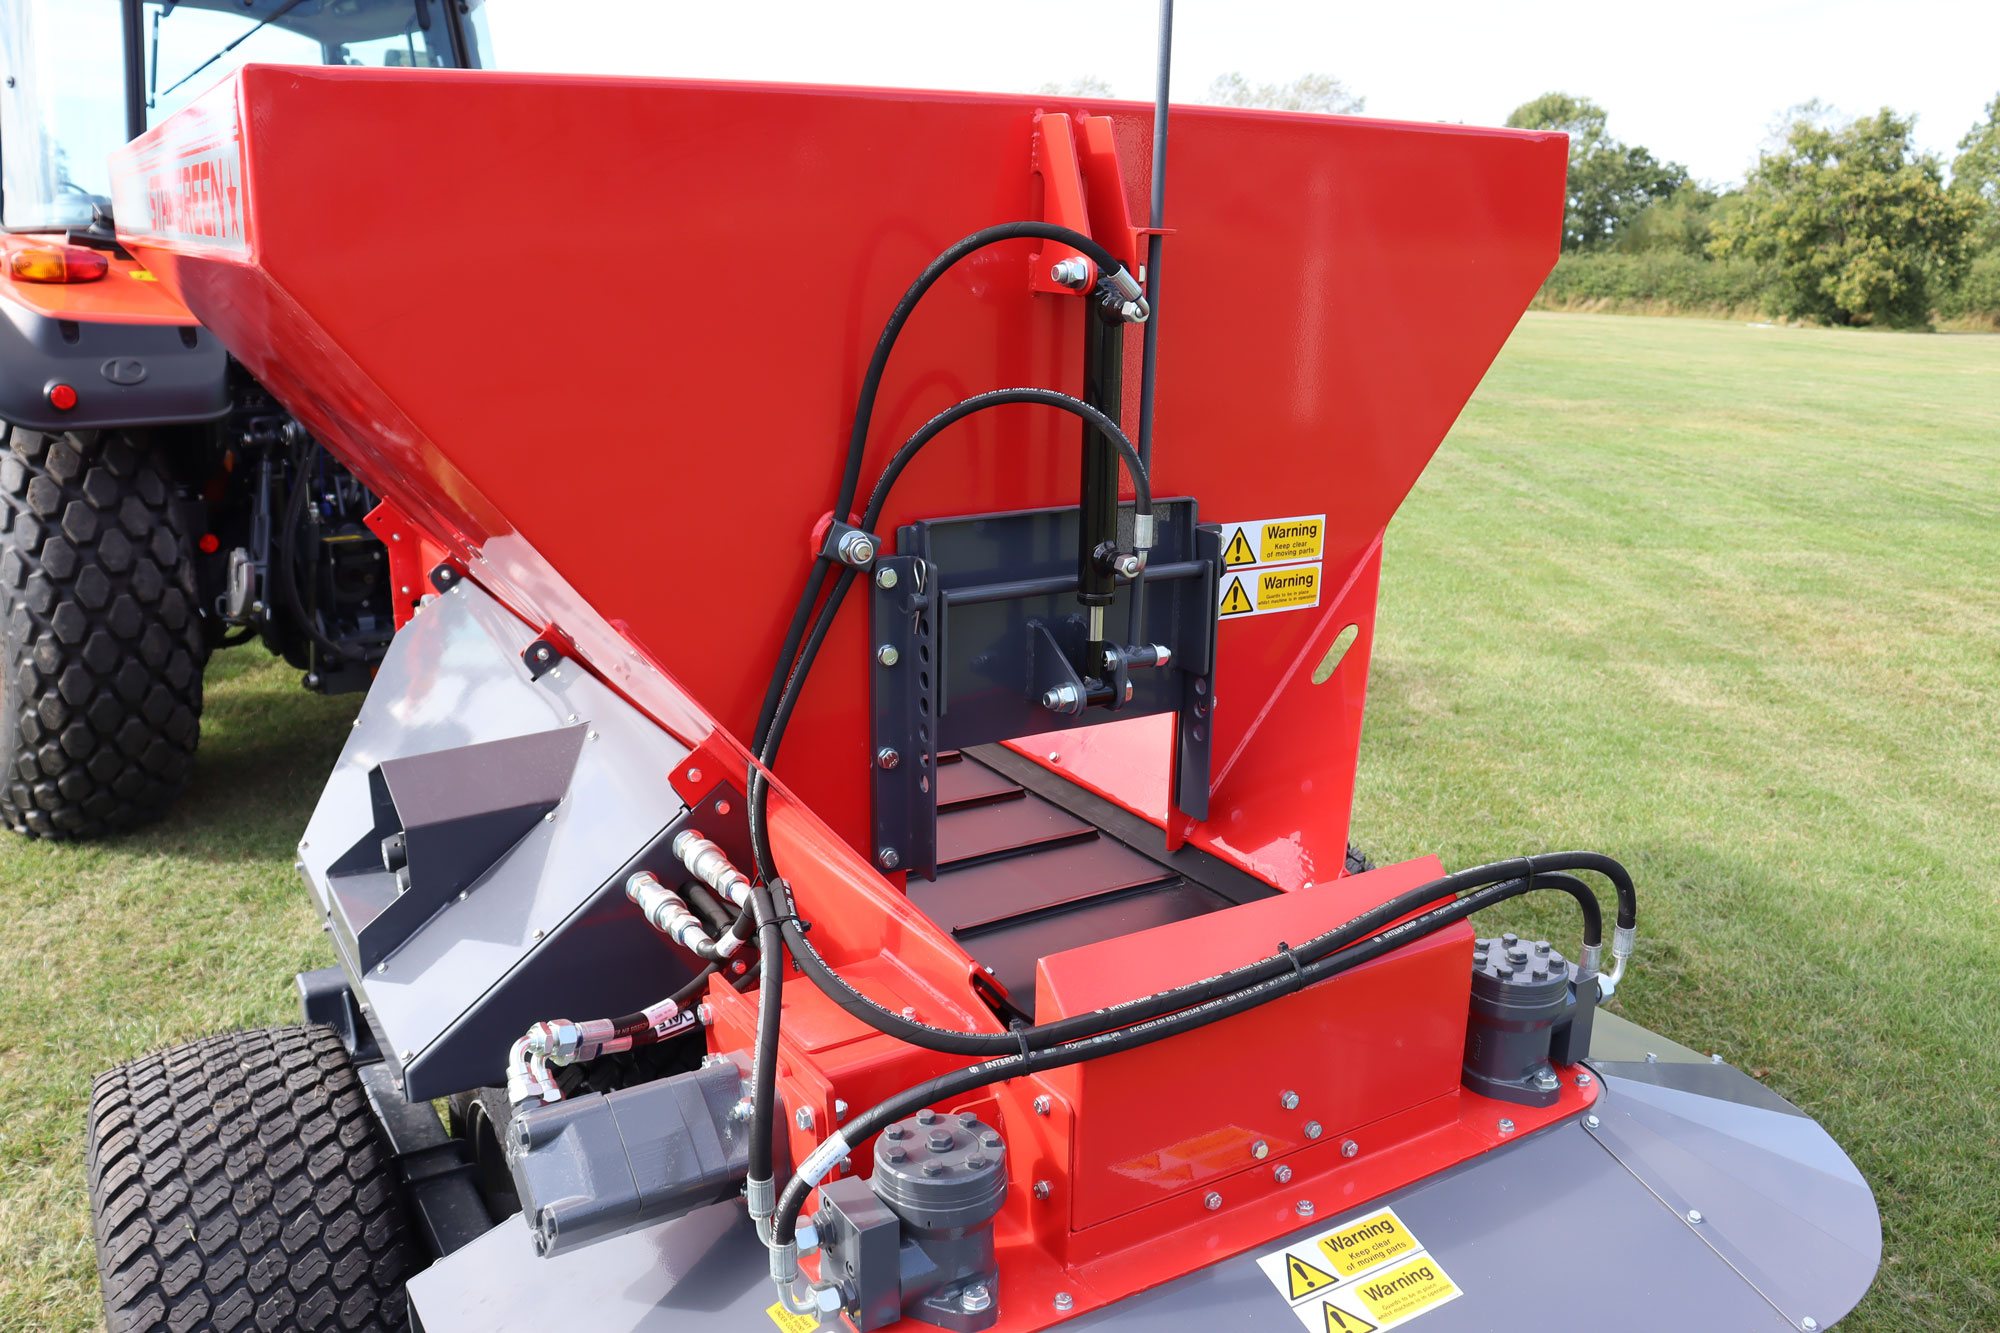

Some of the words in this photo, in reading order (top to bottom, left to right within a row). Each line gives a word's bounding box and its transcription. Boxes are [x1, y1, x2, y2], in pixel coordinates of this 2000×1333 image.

[1267, 523, 1317, 540] Warning
[1275, 543, 1291, 551] Keep
[1275, 549, 1297, 557] moving
[1299, 547, 1314, 555] parts
[1264, 573, 1314, 590] Warning
[1382, 920, 1417, 939] INTERPUMP
[1108, 995, 1152, 1012] INTERPUMP
[1129, 1021, 1157, 1034] EXCEEDS
[1156, 1017, 1166, 1025] EN
[1165, 1014, 1177, 1023] 853
[1200, 998, 1224, 1013] 100R1AT
[1227, 992, 1237, 1002] DN
[1236, 991, 1244, 999] 10
[1243, 988, 1253, 997] I.D.
[984, 1050, 1037, 1070] INTERPUP
[778, 1196, 787, 1212] DN
[784, 1185, 792, 1198] 10
[1324, 1219, 1395, 1253] Warning
[1346, 1262, 1355, 1271] of
[1357, 1252, 1386, 1267] moving
[1386, 1241, 1407, 1255] parts
[1348, 1248, 1371, 1260] Keep
[1371, 1238, 1391, 1251] clear
[1363, 1266, 1435, 1302] Warning
[1378, 1310, 1393, 1321] whilst
[1393, 1301, 1416, 1313] machine
[1427, 1284, 1452, 1297] operation
[1381, 1299, 1402, 1311] Guards
[1422, 1283, 1437, 1293] place
